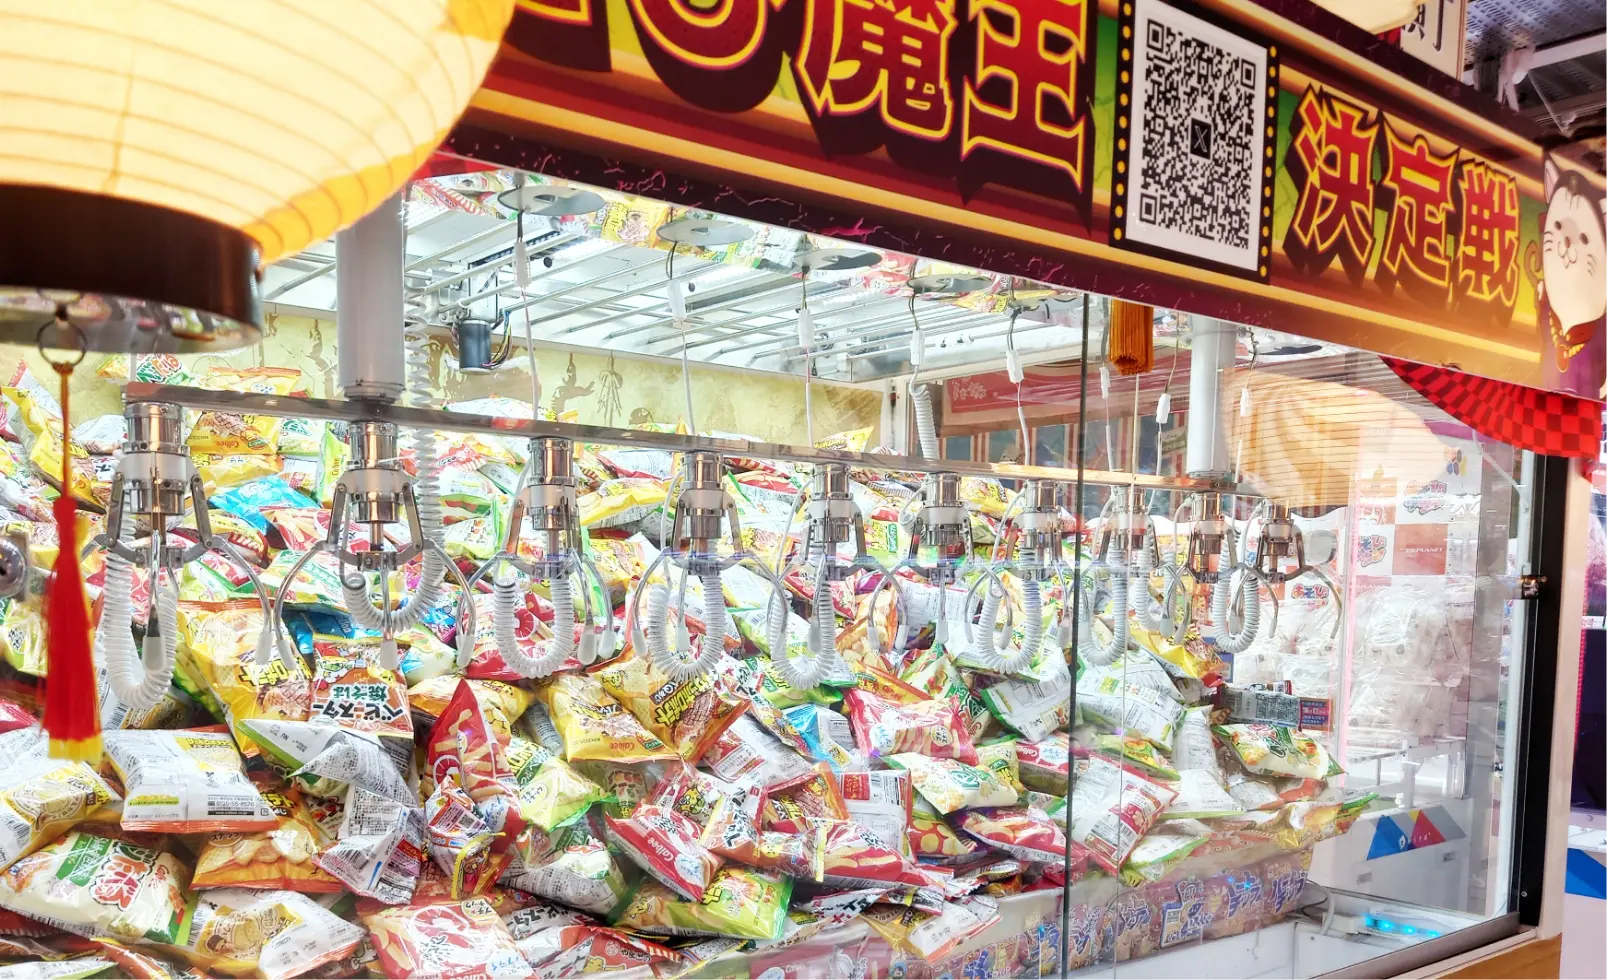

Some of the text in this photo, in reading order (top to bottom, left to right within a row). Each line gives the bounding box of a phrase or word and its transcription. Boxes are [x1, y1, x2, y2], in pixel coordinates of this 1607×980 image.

[1295, 88, 1520, 308] 決定戦
[333, 683, 388, 701] 焼そば
[312, 700, 403, 720] ベビースター
[647, 838, 676, 862] Calbee
